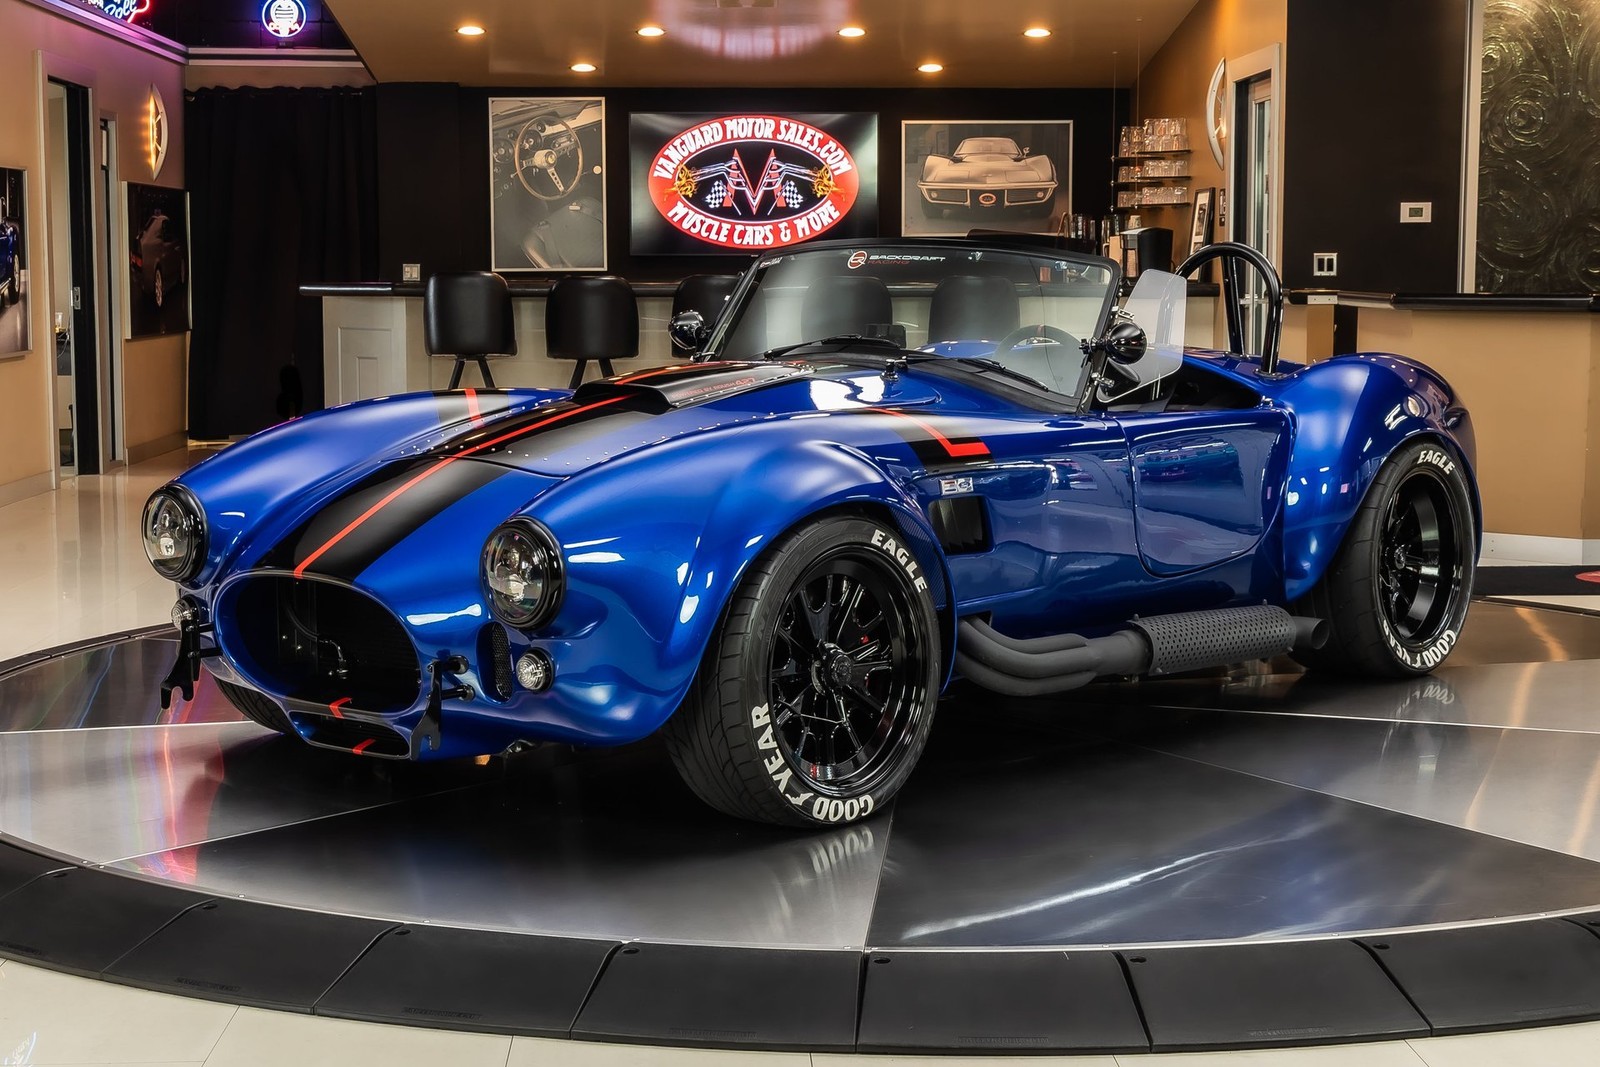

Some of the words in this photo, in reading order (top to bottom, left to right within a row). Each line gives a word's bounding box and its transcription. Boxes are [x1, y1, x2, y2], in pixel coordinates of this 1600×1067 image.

[653, 122, 724, 179] VANGUARD
[724, 117, 776, 140] MOTOR
[777, 120, 853, 176] SALES.COM
[667, 200, 732, 243] MUSCLE
[733, 223, 774, 246] CARS
[778, 222, 791, 243] &
[793, 200, 841, 239] MORE
[869, 254, 946, 262] BACKDRAFT
[1417, 450, 1455, 475] EAGLE
[871, 529, 928, 593] EAGLE
